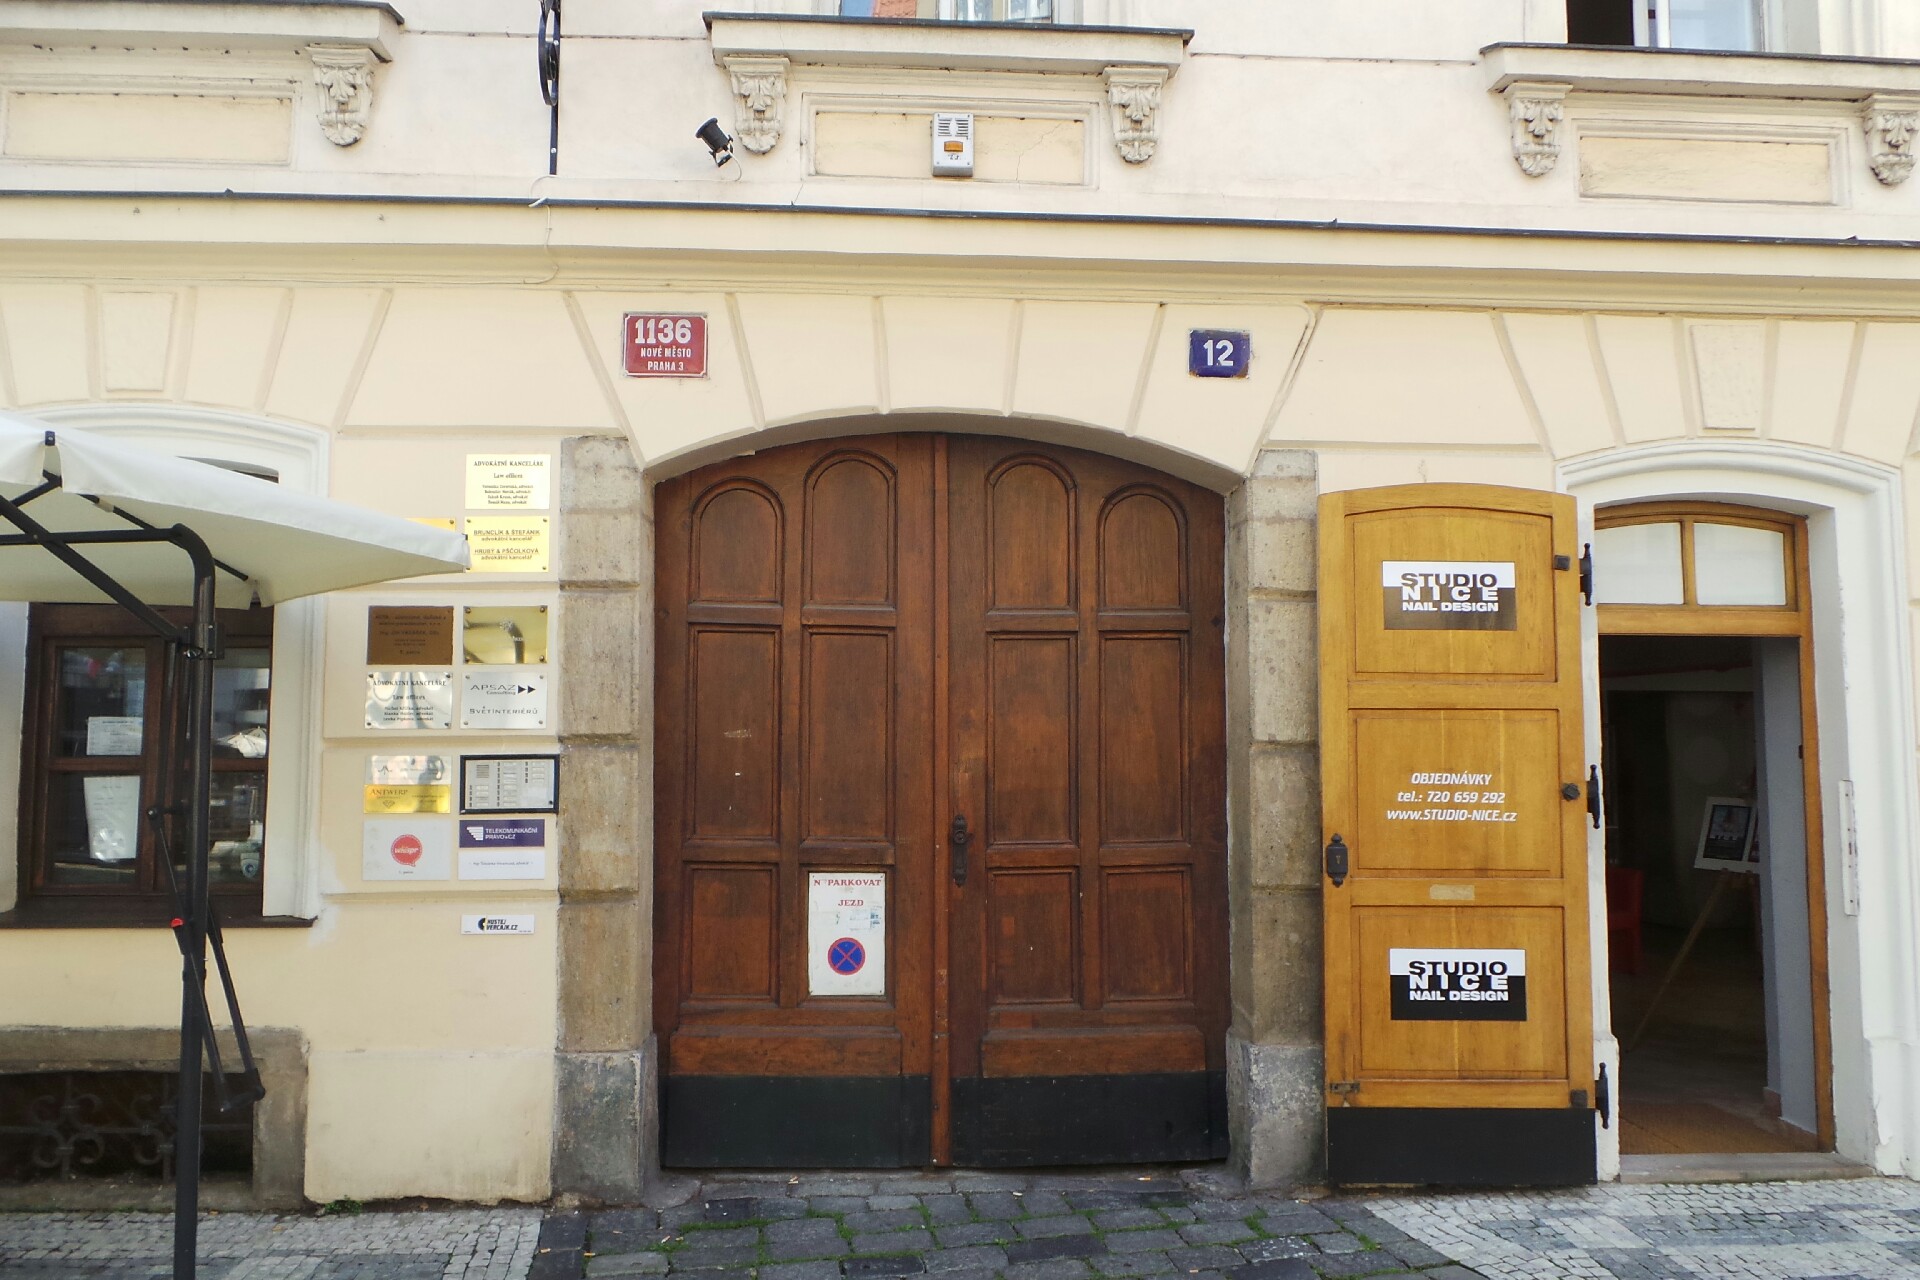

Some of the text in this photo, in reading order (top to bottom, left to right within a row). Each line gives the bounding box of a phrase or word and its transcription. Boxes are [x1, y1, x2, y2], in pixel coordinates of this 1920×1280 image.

[634, 318, 692, 344] 1136
[640, 345, 692, 358] NOVÉ MĚSTO
[1203, 339, 1234, 366] 12
[647, 361, 684, 371] PRAHA 3
[1401, 572, 1498, 588] STUDIO
[1402, 586, 1499, 601] NICE
[1402, 601, 1499, 612] NAIL DESIGN
[1411, 770, 1492, 785] OBJEDNÁVKY
[1397, 791, 1506, 804] tel.: 720 659 292
[1408, 960, 1508, 976] STUDIO
[1409, 974, 1509, 990] NICE
[1409, 990, 1509, 1001] NAIL DESIGN
